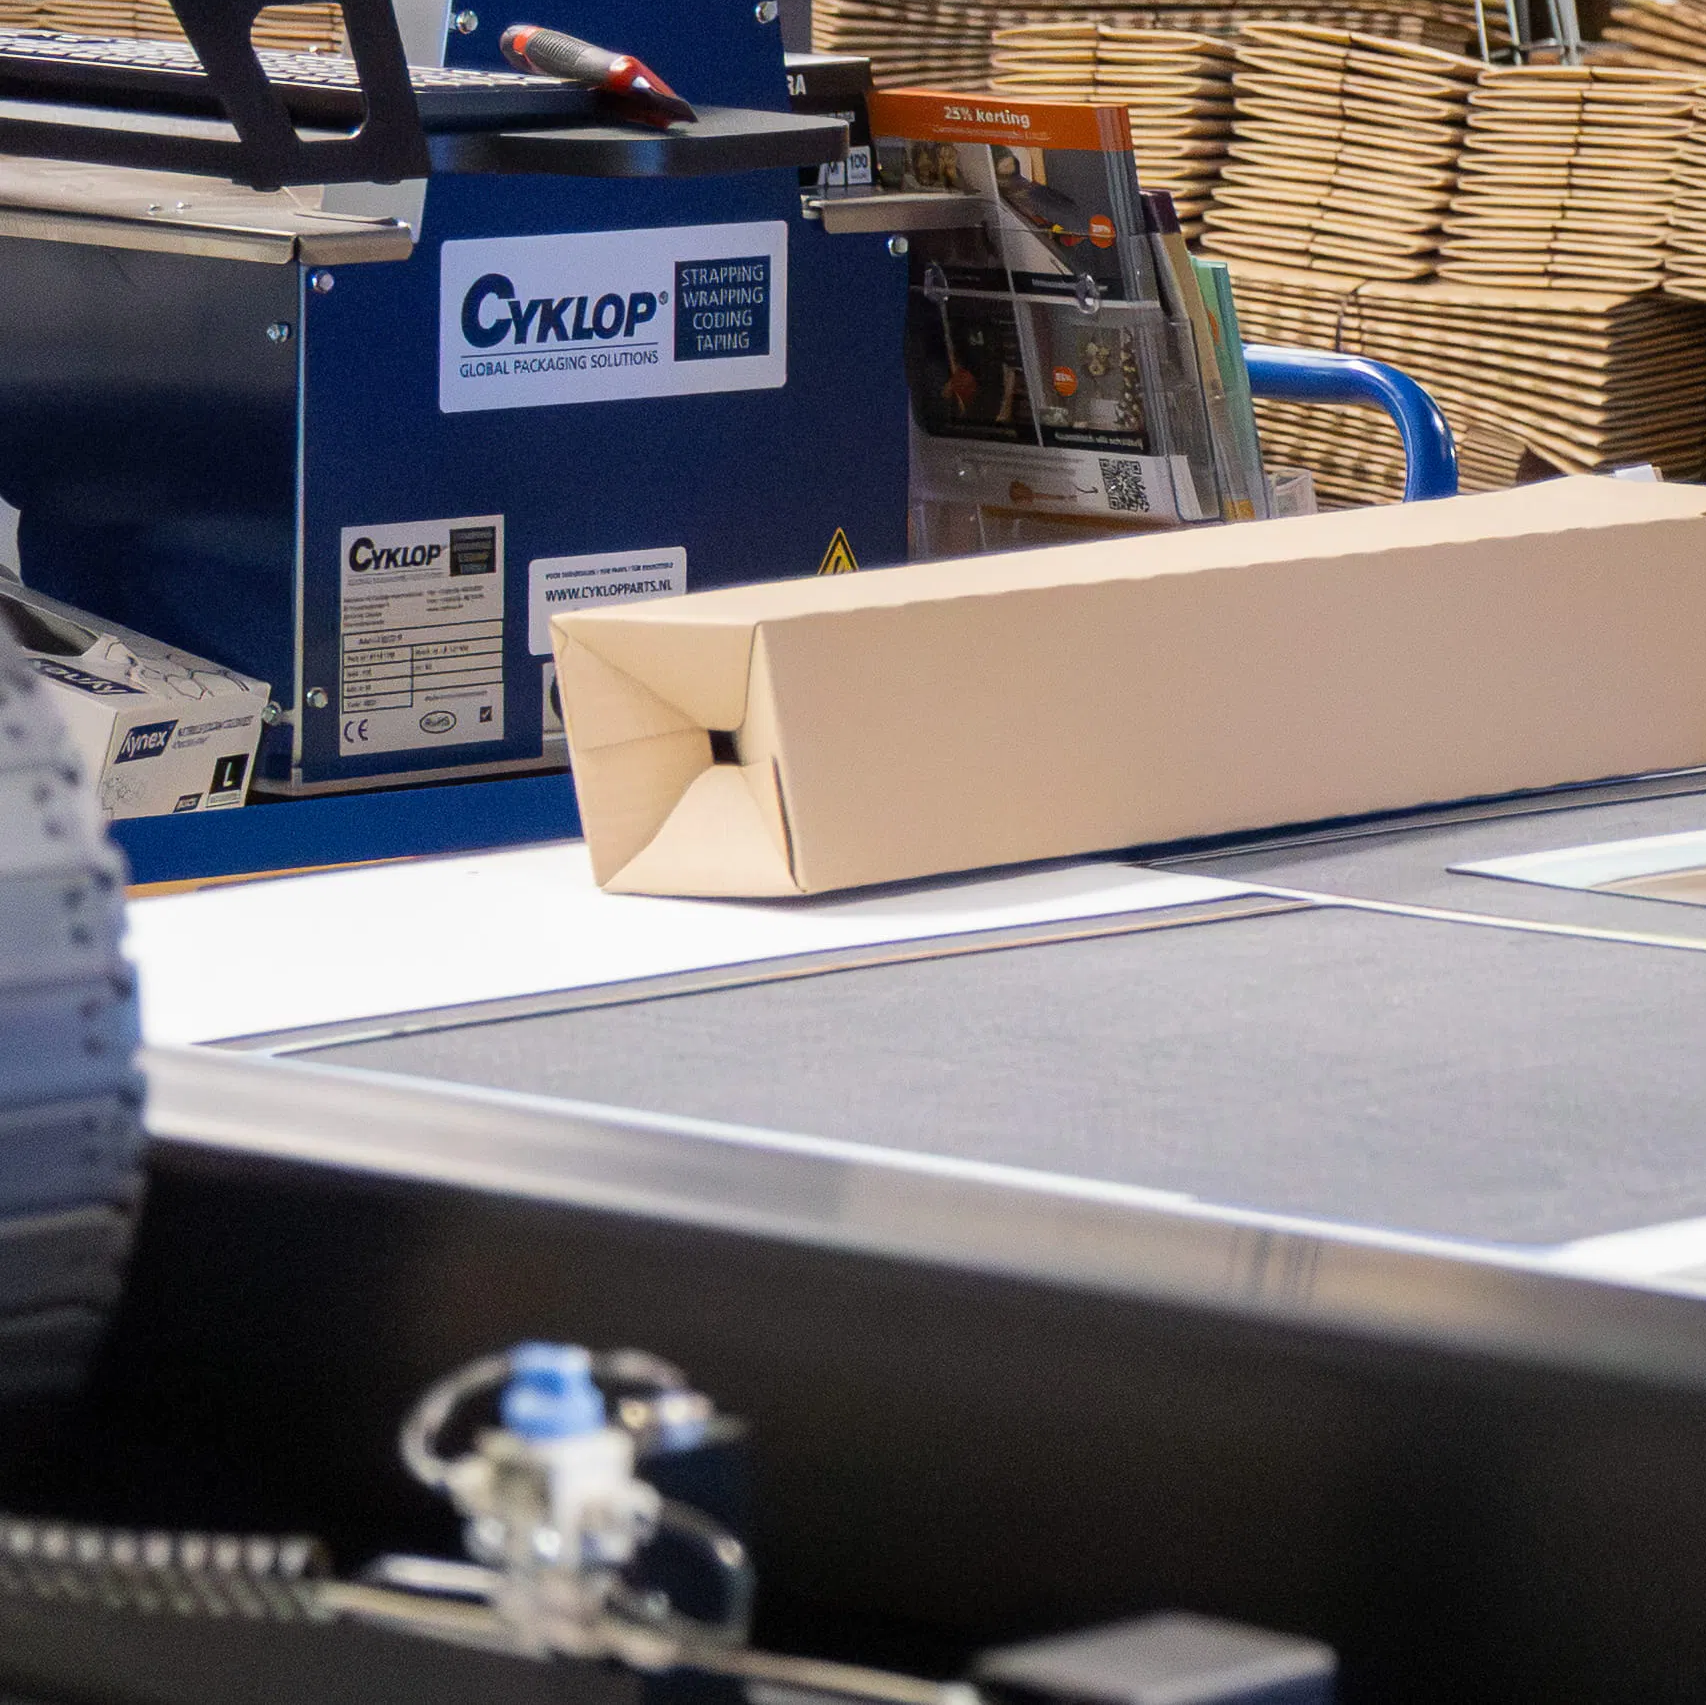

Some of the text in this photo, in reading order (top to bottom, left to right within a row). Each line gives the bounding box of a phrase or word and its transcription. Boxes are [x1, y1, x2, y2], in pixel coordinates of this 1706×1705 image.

[976, 109, 1030, 129] korting
[681, 264, 764, 287] STRAPPING
[682, 286, 764, 308] WRAPPING
[692, 309, 753, 330] CODING
[695, 332, 750, 352] TAPING
[460, 350, 659, 378] GLOBAL PACKAGING SOLUTIONS
[545, 579, 673, 602] WWW.CYKLOPPARTS.NL
